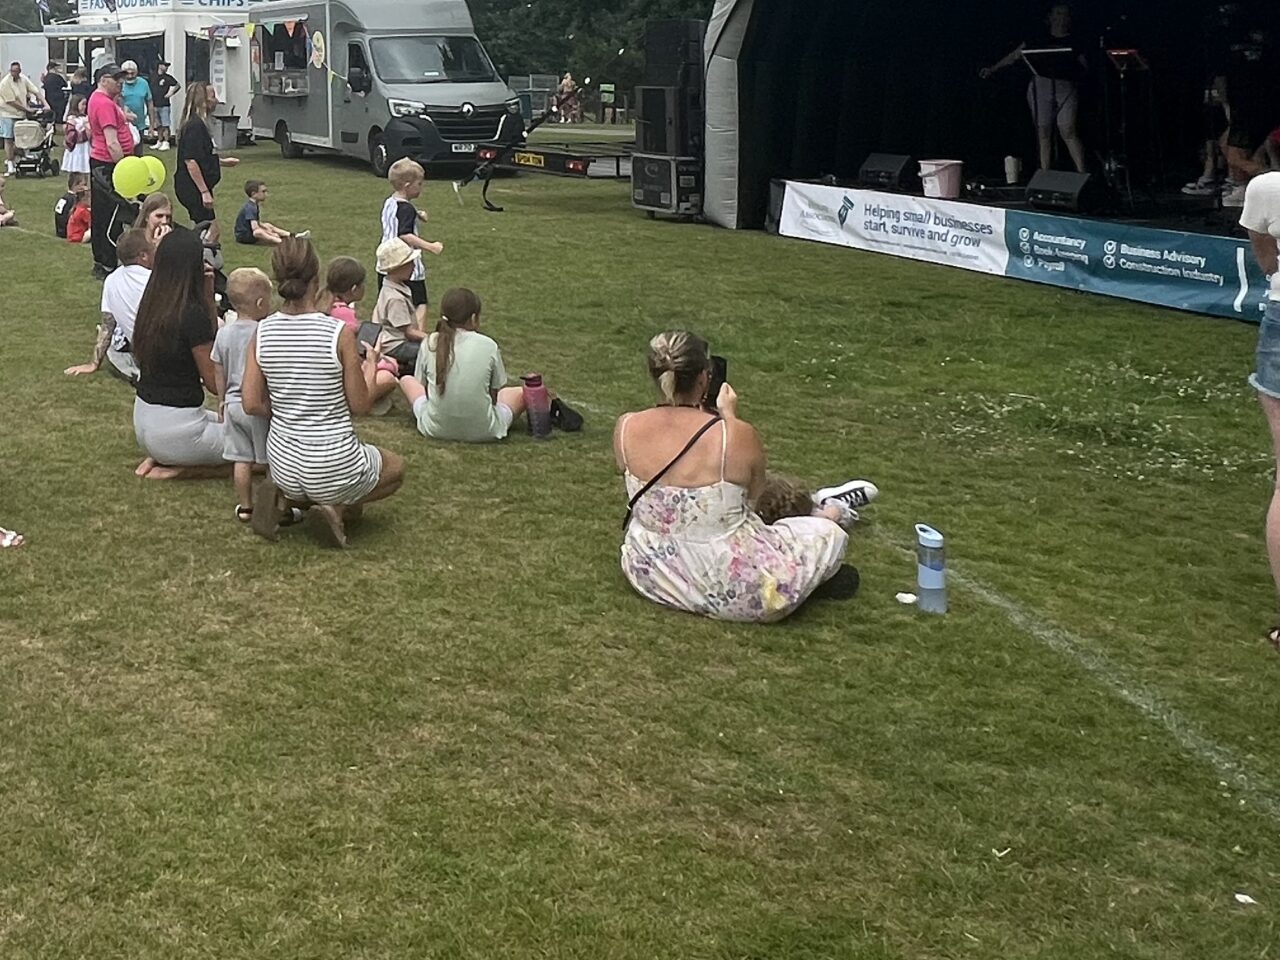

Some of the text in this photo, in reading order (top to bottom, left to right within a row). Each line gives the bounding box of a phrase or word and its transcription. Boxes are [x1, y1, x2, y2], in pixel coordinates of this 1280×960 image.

[863, 203, 993, 234] Helping small businesses
[863, 220, 981, 248] start, survive and grow
[1033, 231, 1086, 250] Accountancy
[1120, 243, 1206, 268] Business Advisory
[1119, 258, 1224, 287] Construction Industry
